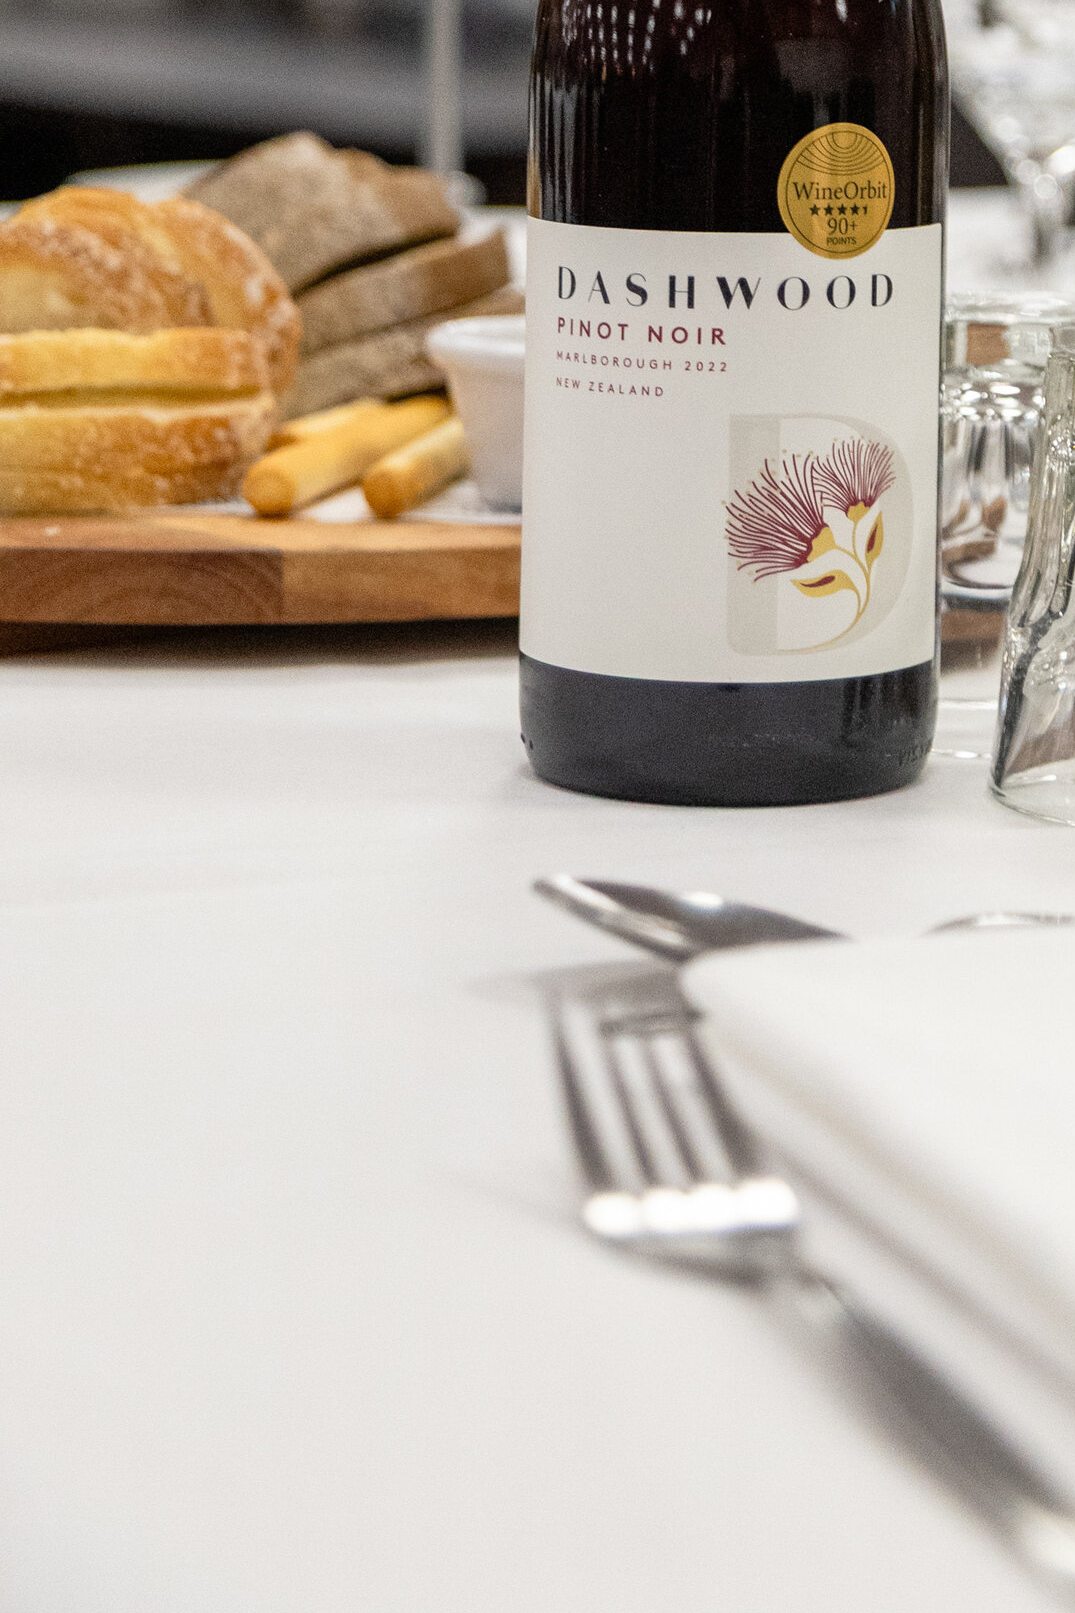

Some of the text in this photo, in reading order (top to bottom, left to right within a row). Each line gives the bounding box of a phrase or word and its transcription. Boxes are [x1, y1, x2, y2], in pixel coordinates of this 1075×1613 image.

[792, 181, 888, 201] WineOrbit
[827, 217, 859, 236] 90+
[826, 236, 857, 246] POINTS
[557, 265, 894, 312] DASHWOOD
[557, 317, 727, 346] PINOT NOIR
[556, 351, 728, 373] MARLBOROUGH 2022
[556, 376, 665, 398] NEW ZEALAND
